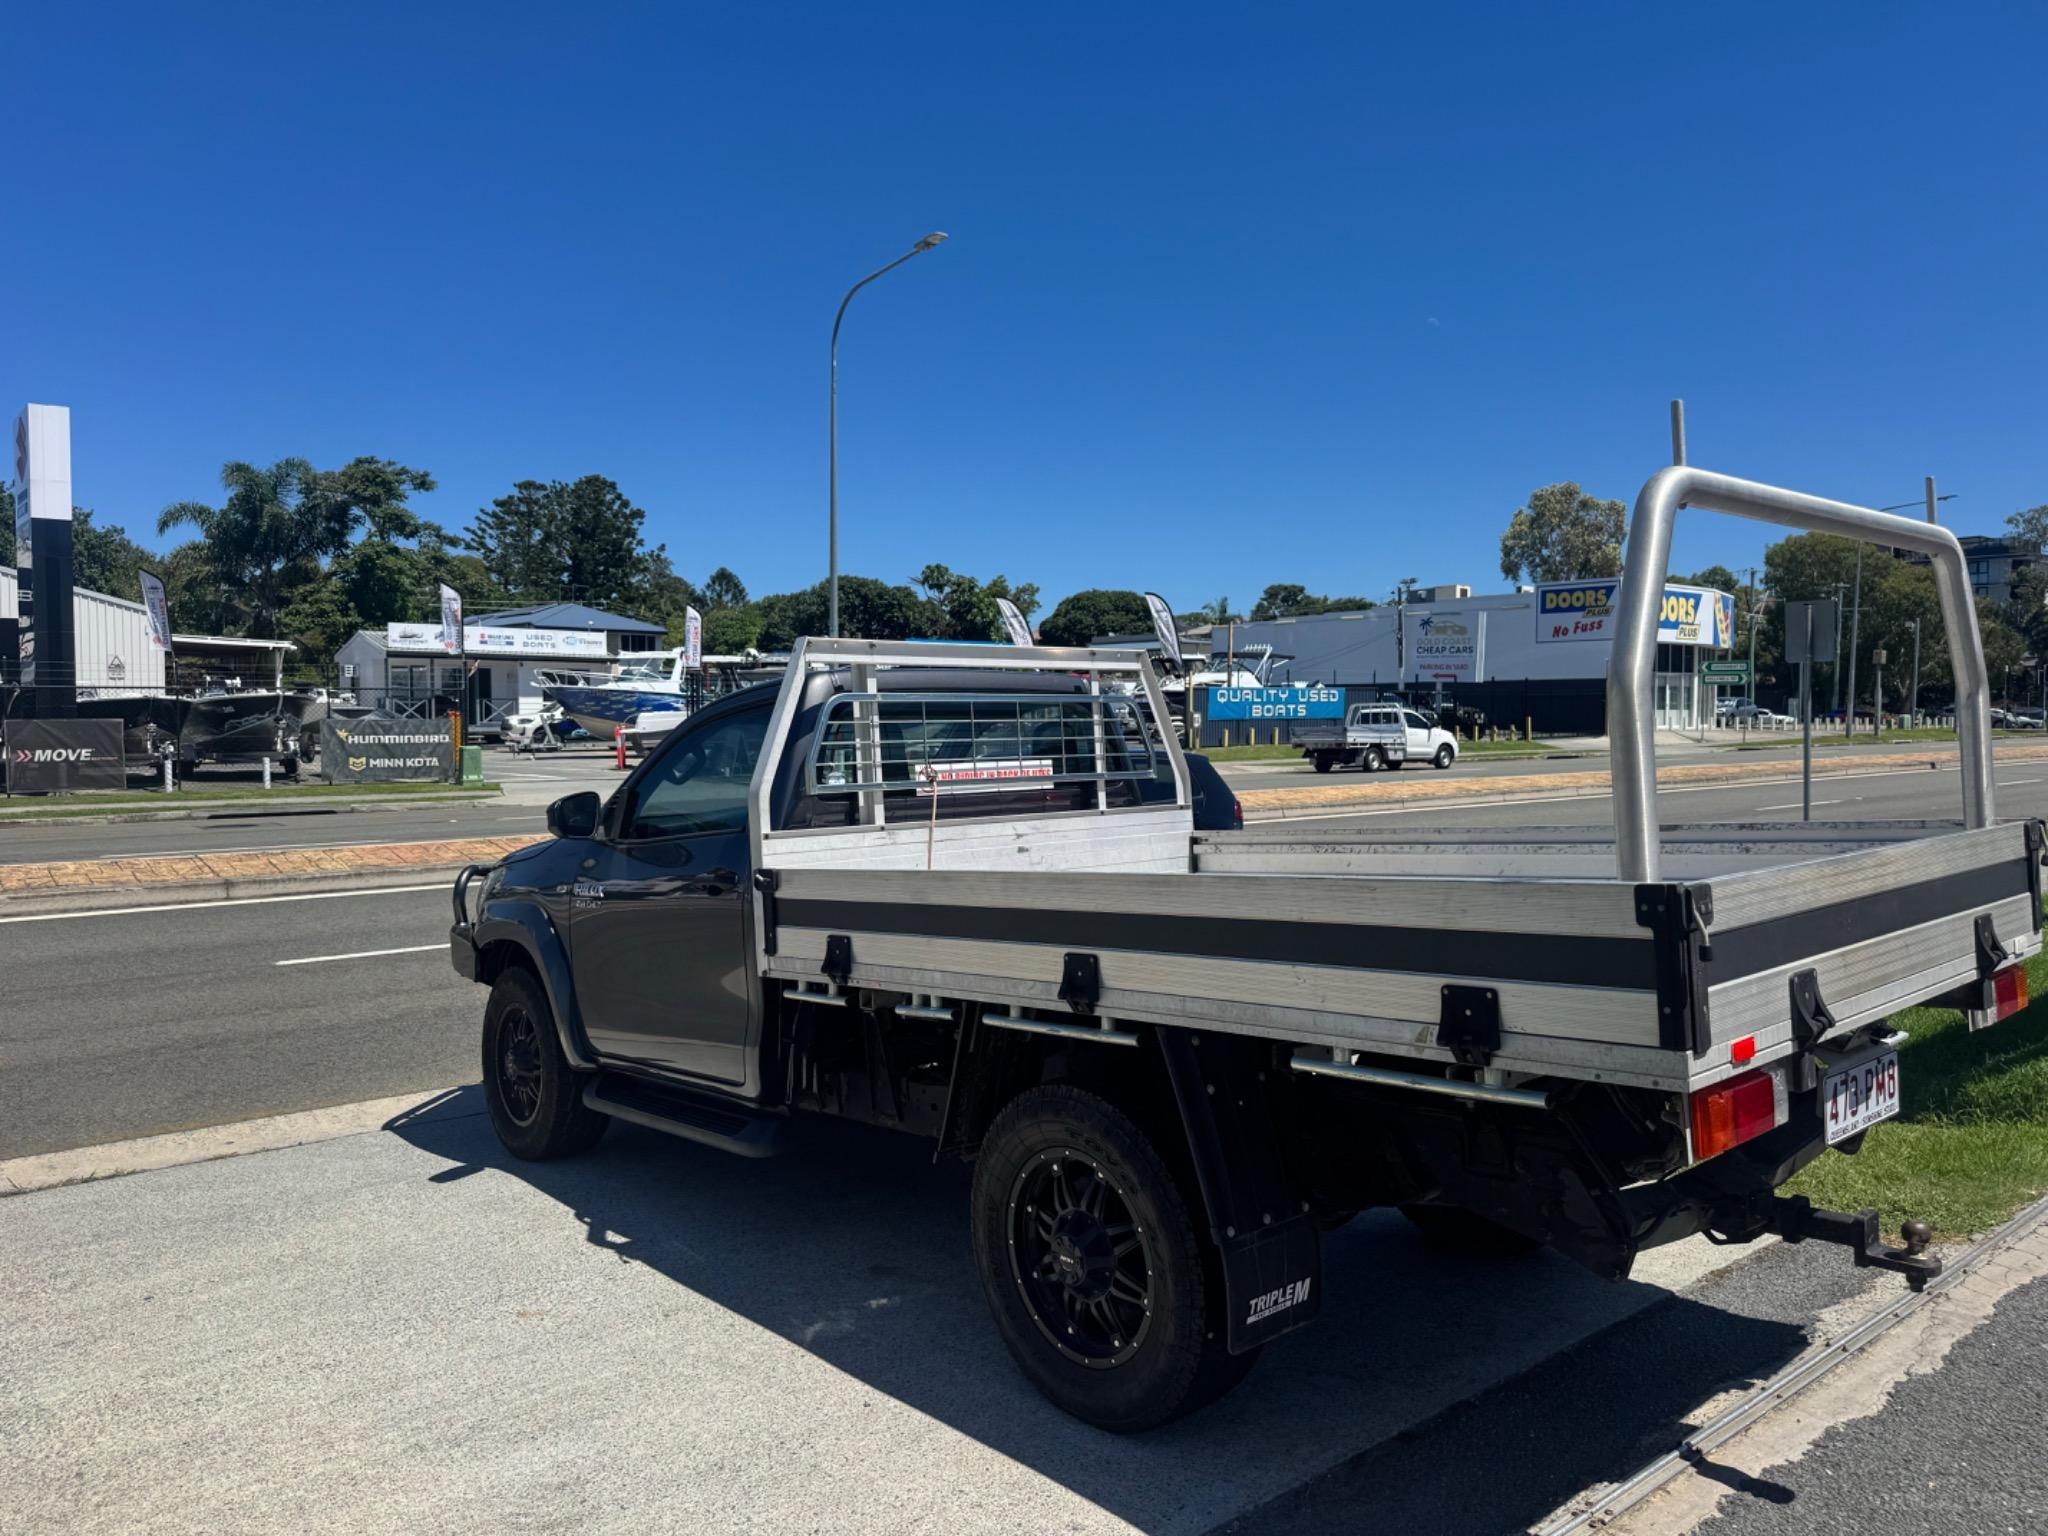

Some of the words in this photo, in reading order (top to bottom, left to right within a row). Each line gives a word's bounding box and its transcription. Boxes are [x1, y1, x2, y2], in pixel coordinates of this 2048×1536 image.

[1545, 589, 1607, 609] DOORS
[1585, 605, 1611, 617] PLUS
[1660, 595, 1696, 623] OORS
[1552, 624, 1569, 638] No
[1573, 619, 1604, 635] Fuss
[1678, 626, 1698, 638] PLUS
[1416, 646, 1447, 655] CHEAP
[1448, 646, 1474, 655] CARS
[1217, 689, 1289, 704] QUALITY
[1298, 689, 1339, 703] USED
[1251, 704, 1307, 717] BOATS
[348, 734, 450, 744] HUMMINBIRD
[34, 748, 93, 762] MOVE
[369, 757, 404, 768] MINN
[406, 756, 440, 767] KOTA
